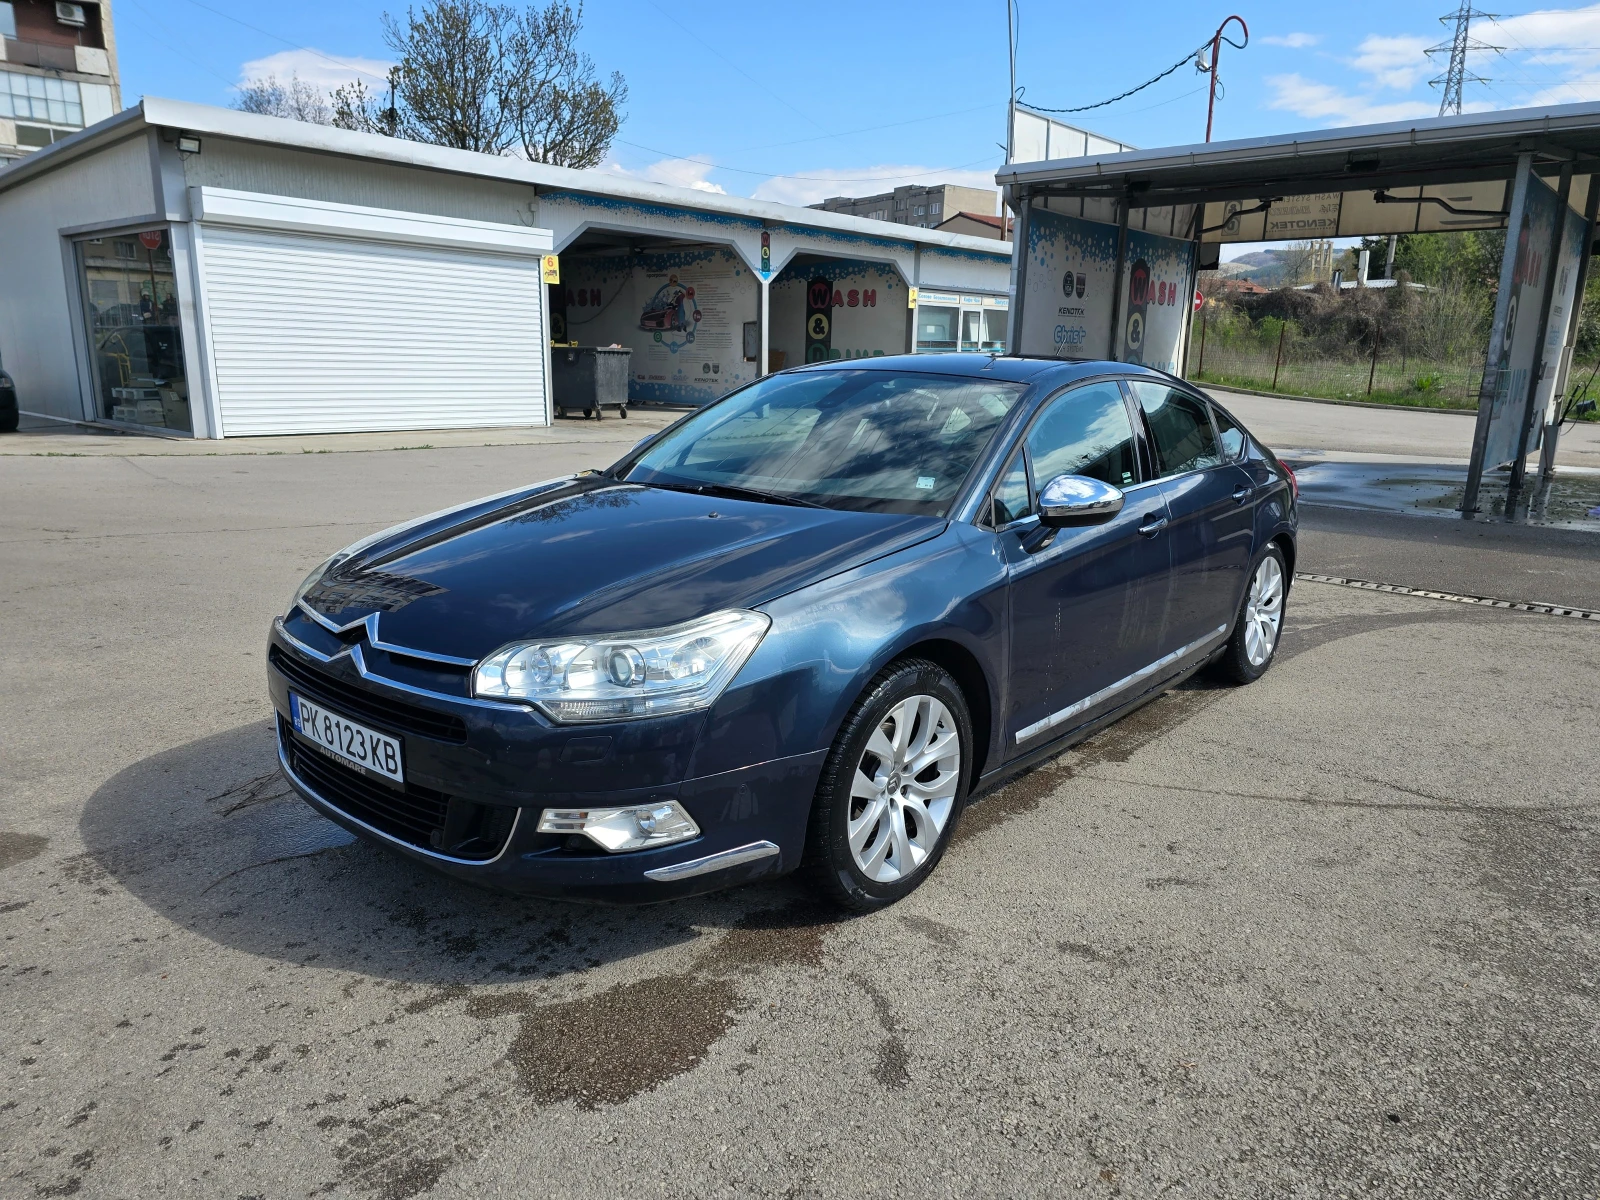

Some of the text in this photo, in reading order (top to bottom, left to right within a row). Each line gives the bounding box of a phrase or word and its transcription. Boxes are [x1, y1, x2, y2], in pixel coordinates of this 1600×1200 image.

[547, 256, 554, 267] 6
[763, 248, 769, 257] &
[811, 286, 877, 308] WASH
[1132, 275, 1177, 306] WASH
[812, 318, 826, 336] &
[1053, 325, 1087, 345] Christ
[1130, 318, 1141, 344] &
[293, 716, 301, 728] BG
[323, 714, 368, 761] 8123
[319, 745, 367, 776] AUTOMARE
